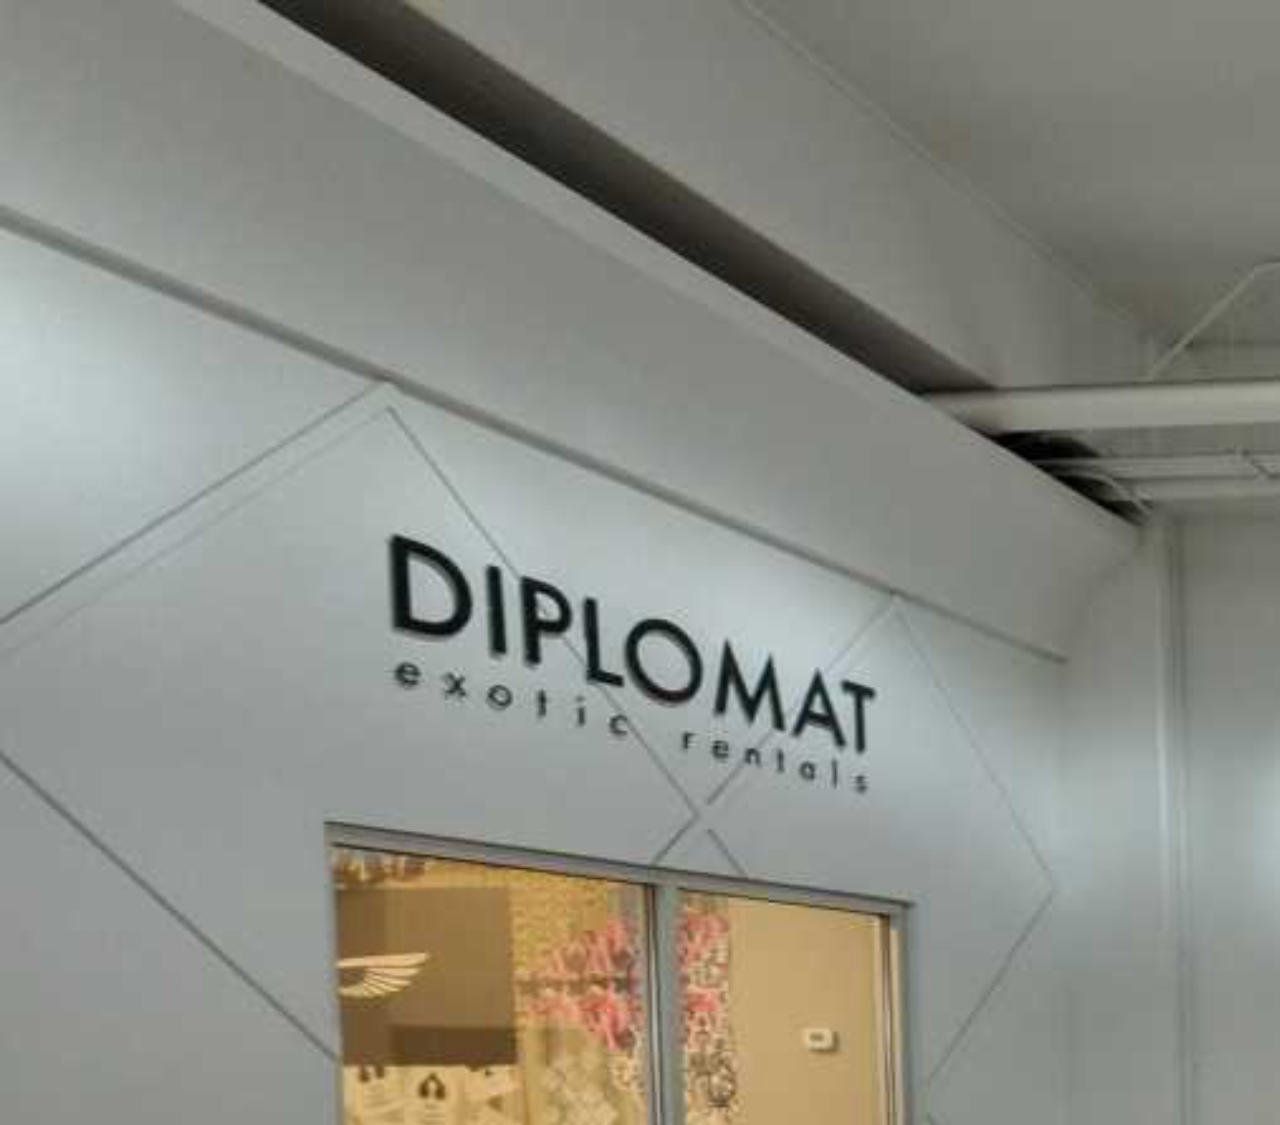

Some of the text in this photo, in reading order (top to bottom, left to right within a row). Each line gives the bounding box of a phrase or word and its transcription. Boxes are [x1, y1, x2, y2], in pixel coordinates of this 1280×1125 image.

[389, 534, 876, 753] DIPLOMAT
[393, 660, 869, 794] exotic rentals
